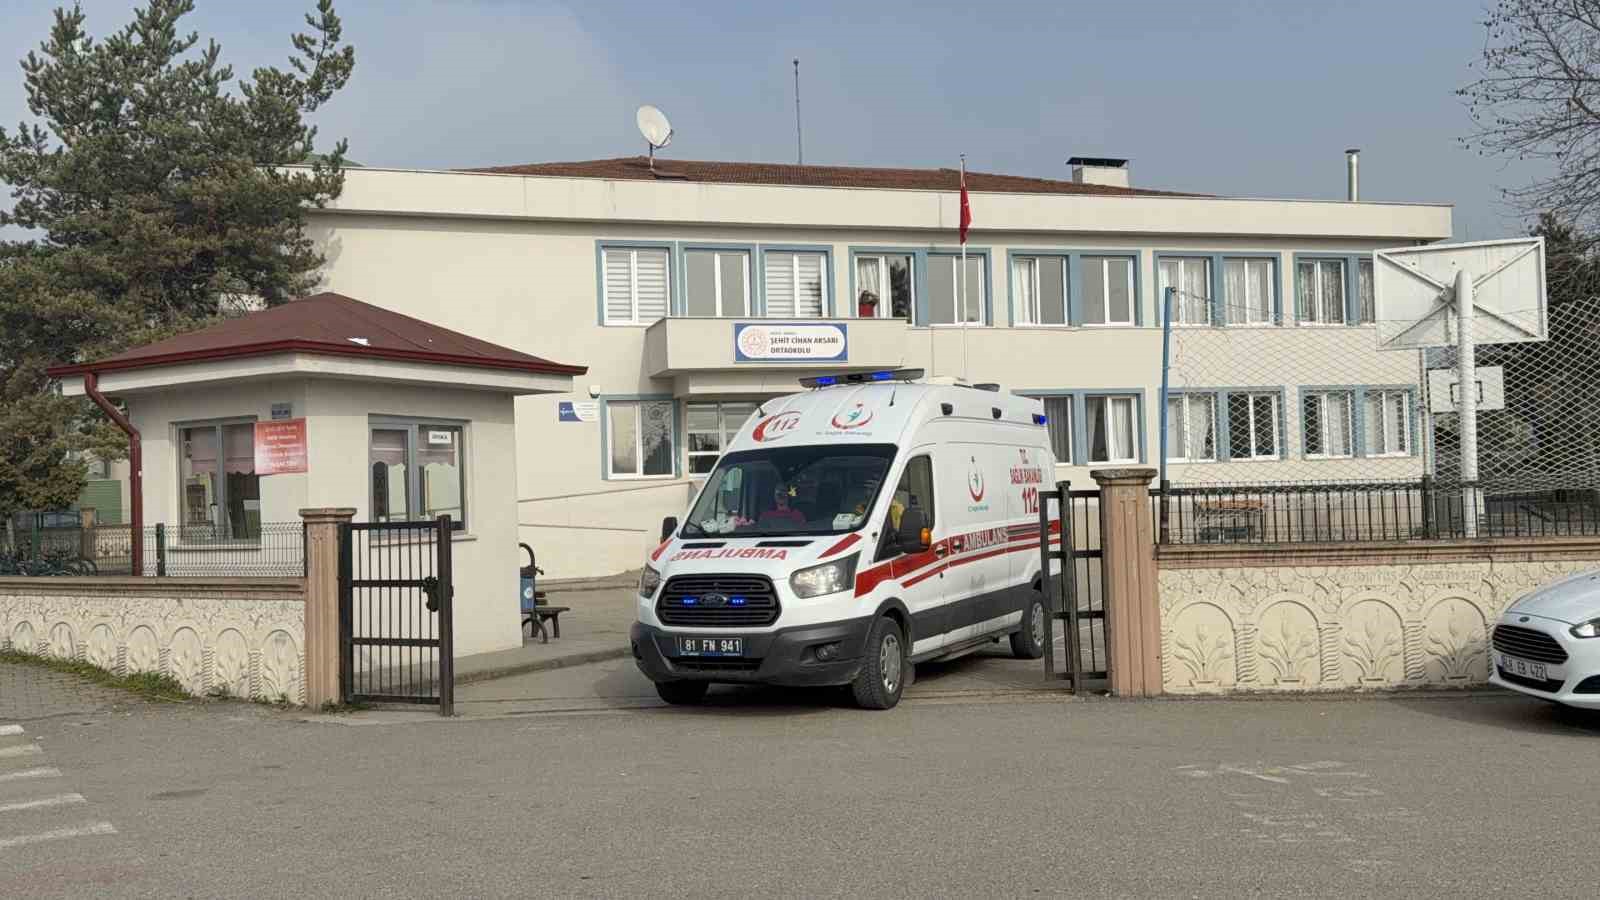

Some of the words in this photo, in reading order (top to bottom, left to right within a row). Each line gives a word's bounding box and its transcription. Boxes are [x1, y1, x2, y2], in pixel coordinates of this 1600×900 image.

[770, 335, 790, 345] ŞEHİT
[791, 335, 813, 344] CİHAN
[770, 346, 811, 354] ORTAOKULU
[771, 417, 800, 432] 112
[1022, 487, 1039, 514] 112
[963, 526, 1009, 552] AMBULANS
[685, 639, 696, 652] 81
[702, 639, 716, 652] FN
[720, 639, 740, 653] 941
